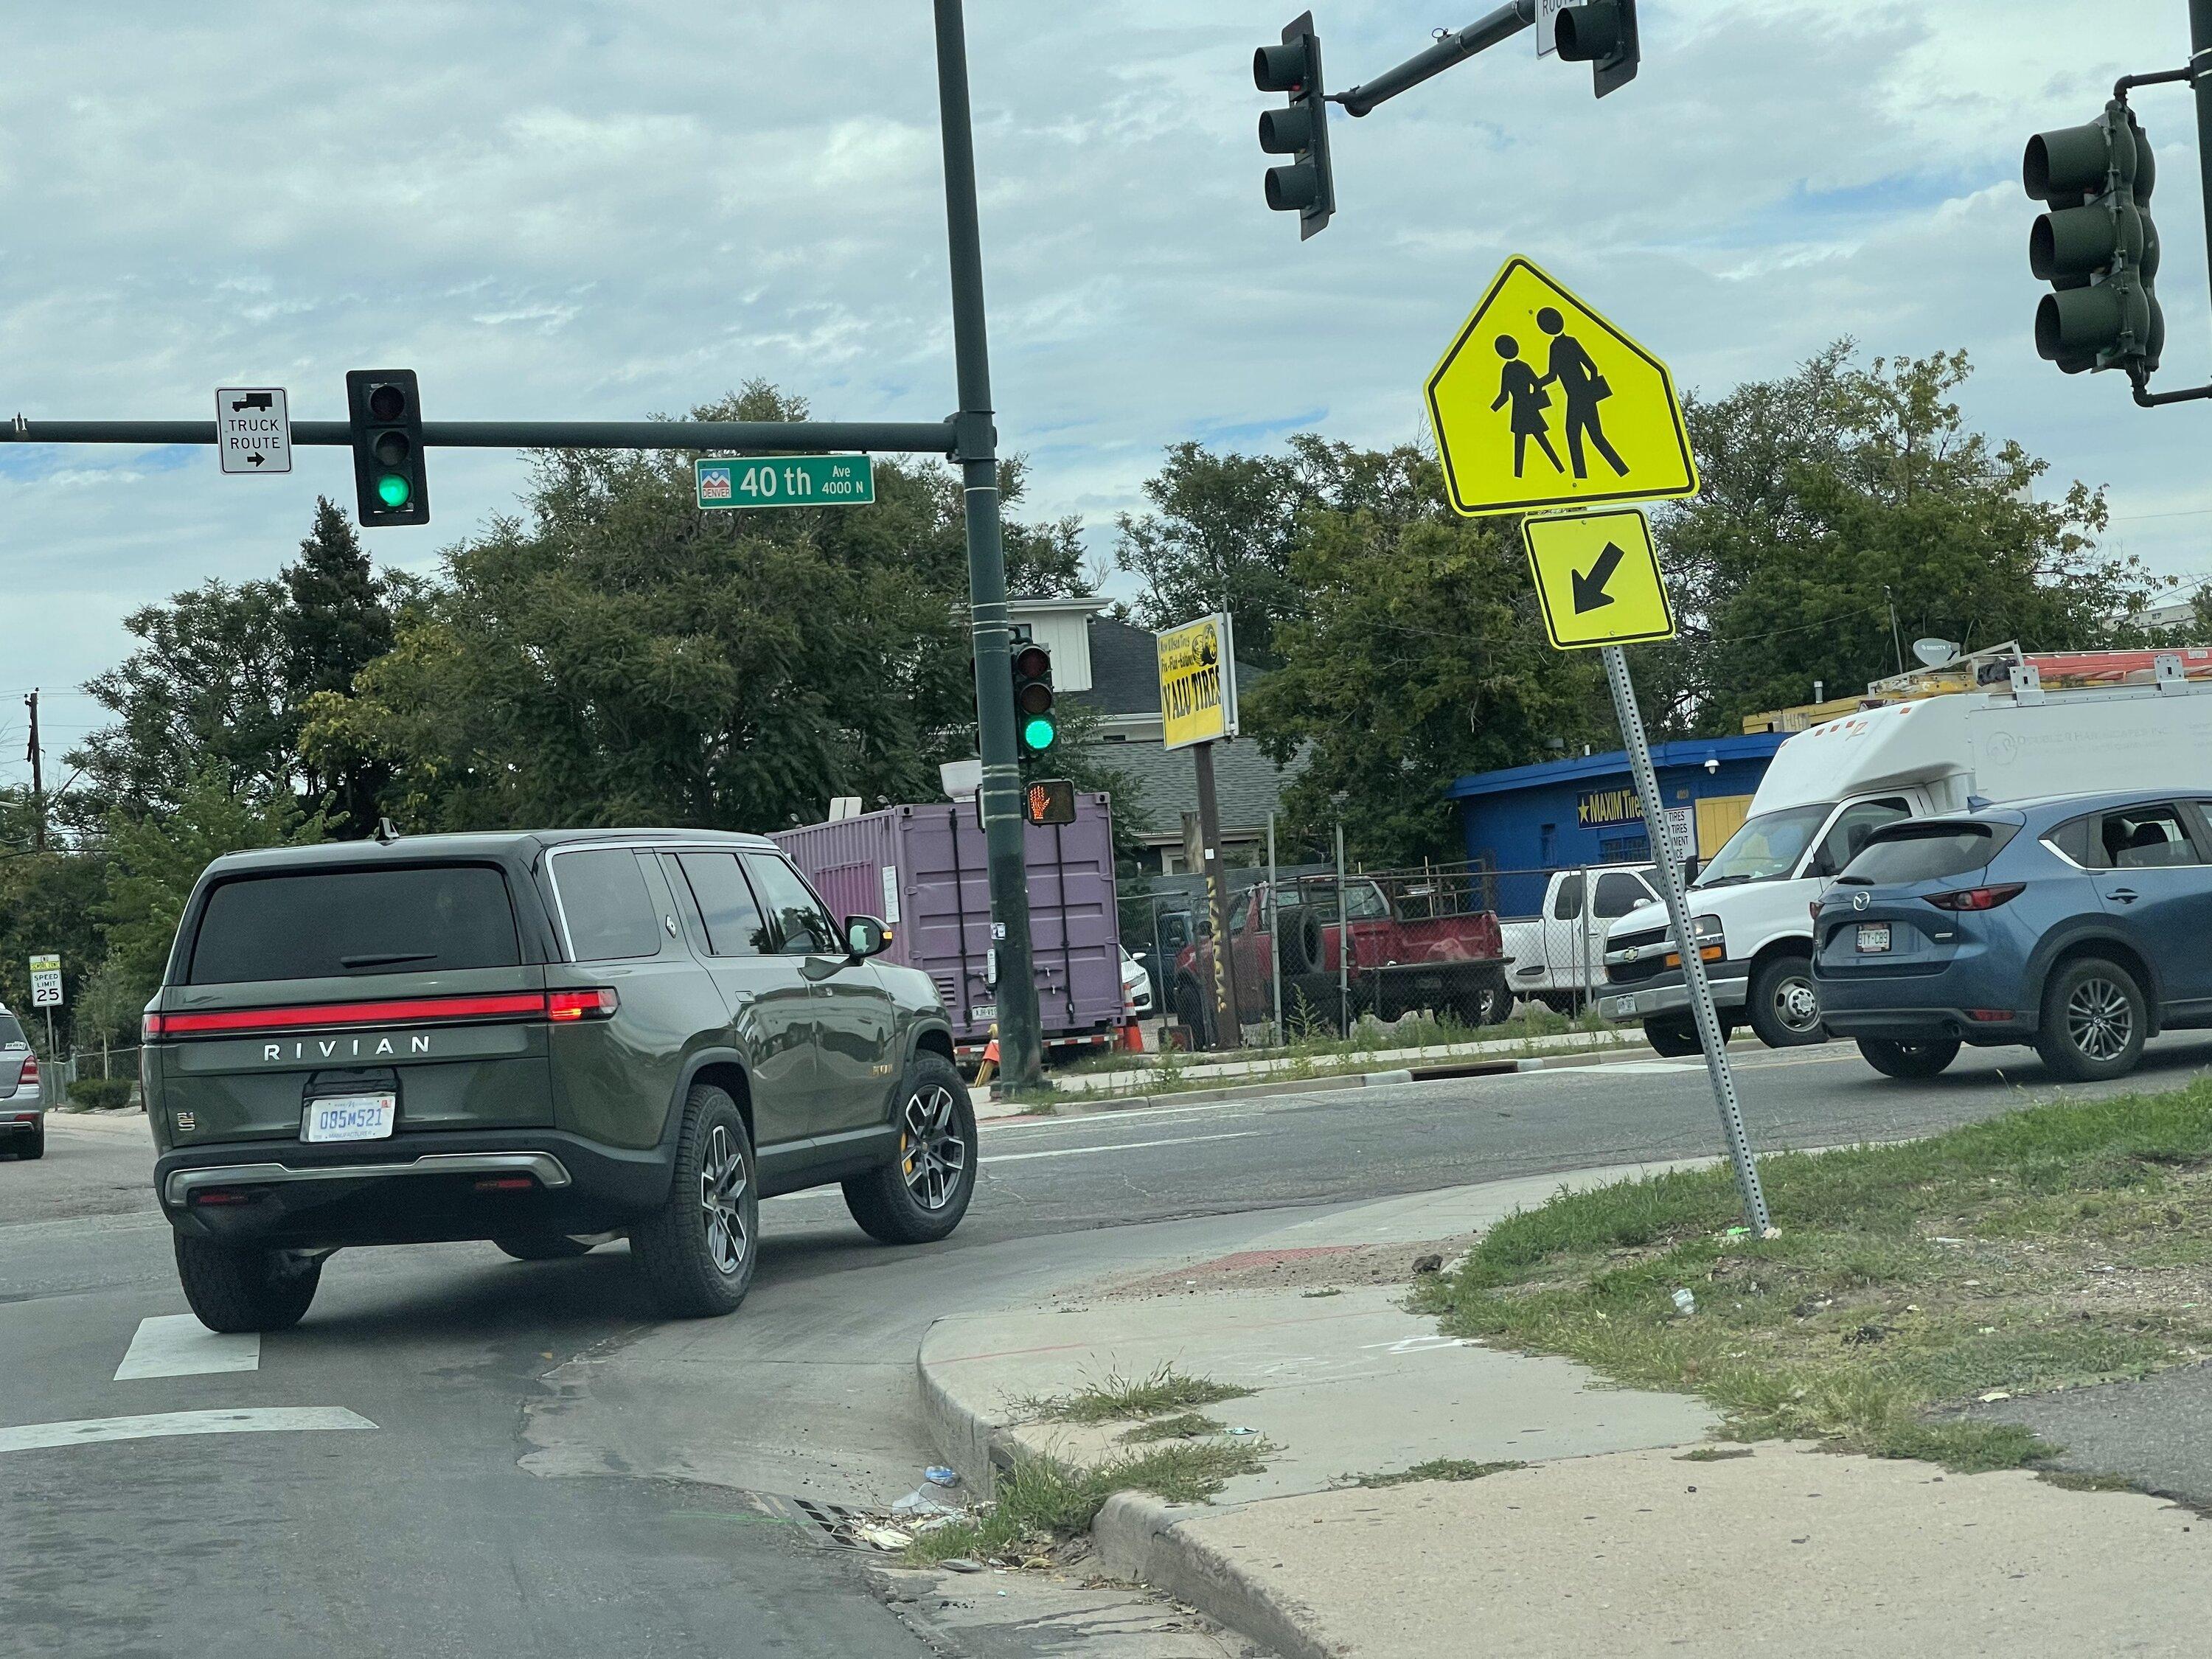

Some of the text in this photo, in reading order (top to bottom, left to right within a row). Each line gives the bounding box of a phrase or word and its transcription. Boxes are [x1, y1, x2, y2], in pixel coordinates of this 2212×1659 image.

[229, 420, 279, 431] TRUCK
[231, 437, 280, 449] ROUTE
[832, 465, 851, 477] Ave
[703, 488, 730, 497] DENVER
[822, 481, 863, 494] 4000 N
[1163, 664, 1221, 722] VALU TIRES
[1590, 790, 1644, 823] MAXIM Tire
[1669, 811, 1685, 821] TIRES
[1672, 824, 1687, 834] TIRES
[37, 988, 59, 1001] 25
[264, 1035, 429, 1061] RIVIAN
[320, 1108, 382, 1130] 085M521
[329, 1130, 372, 1138] MANUFACTURER
